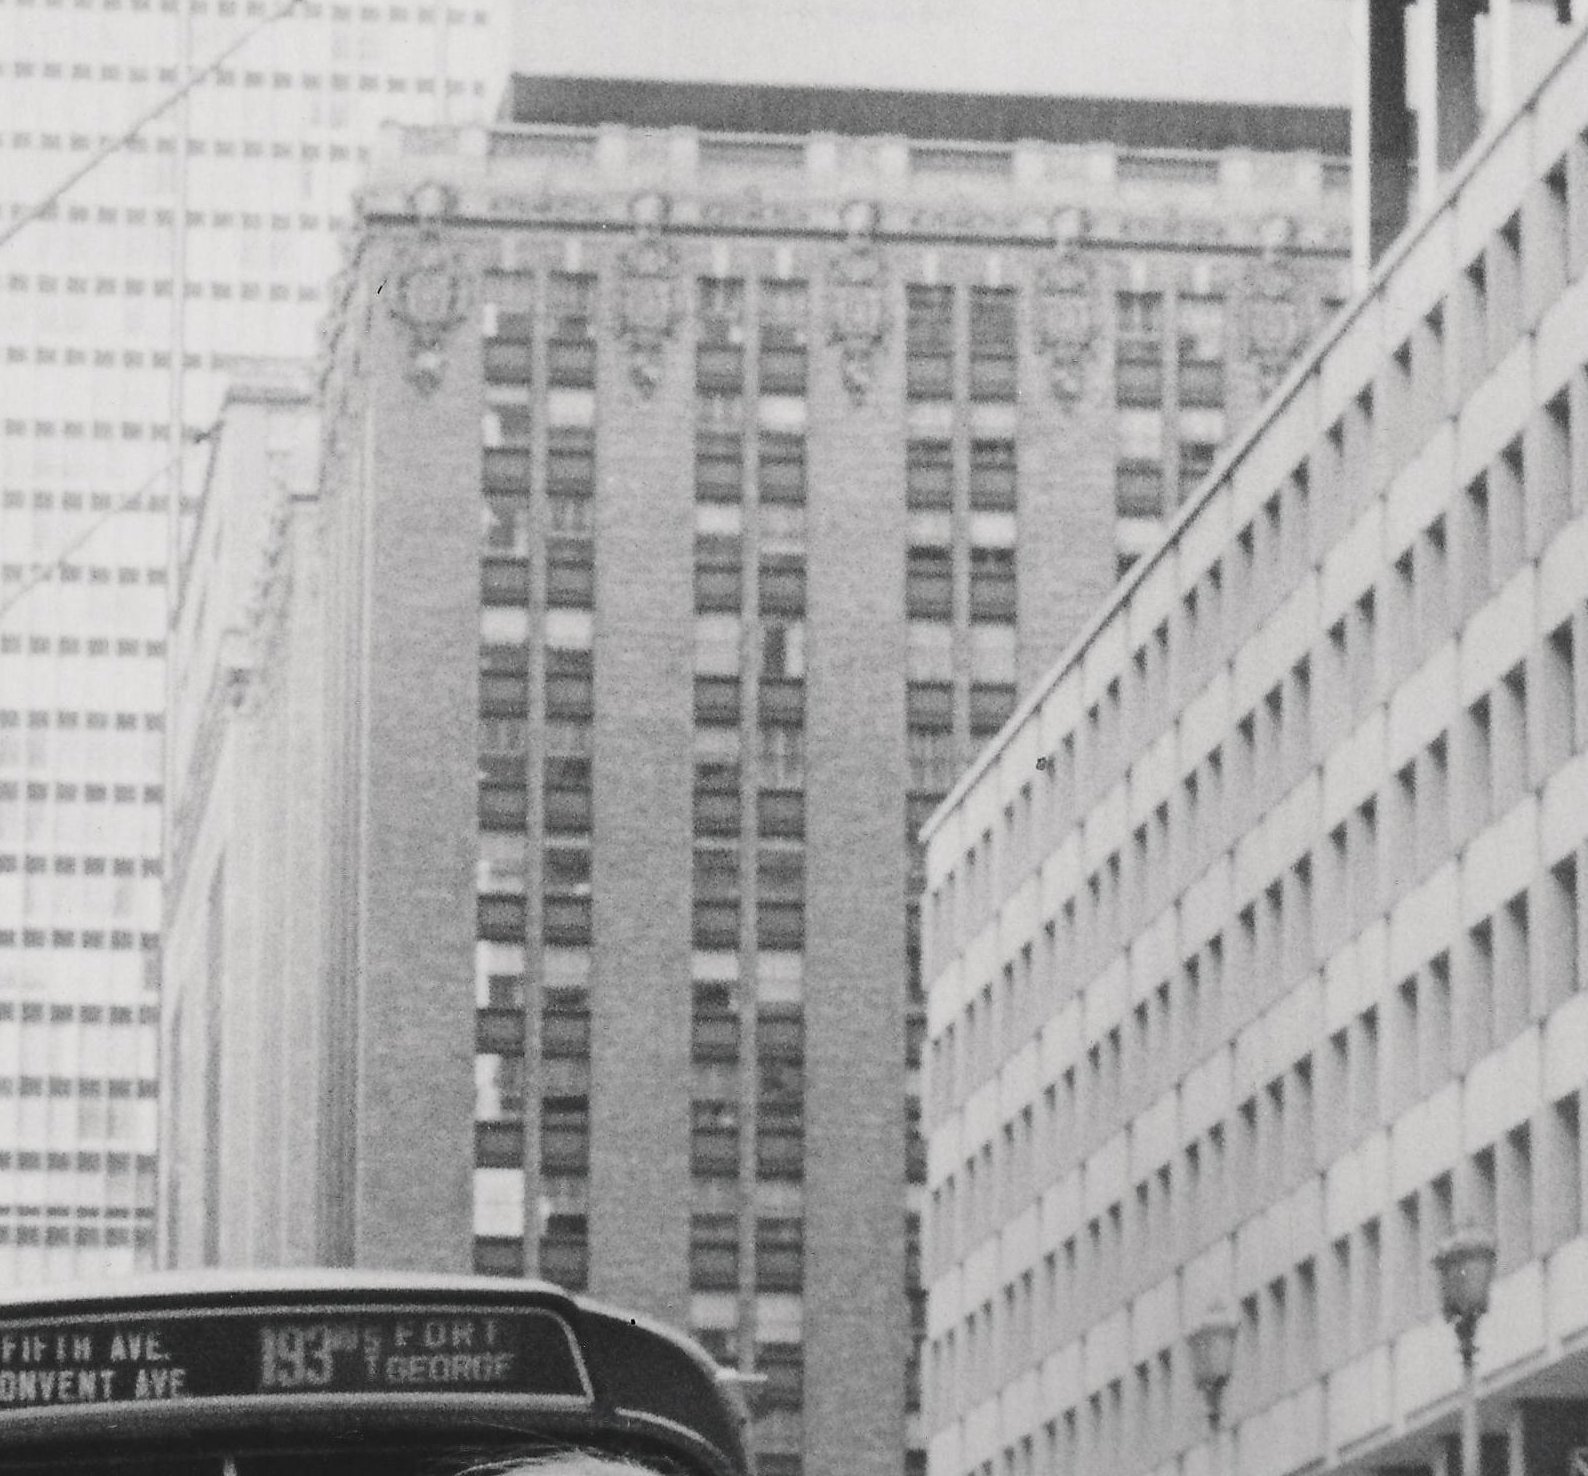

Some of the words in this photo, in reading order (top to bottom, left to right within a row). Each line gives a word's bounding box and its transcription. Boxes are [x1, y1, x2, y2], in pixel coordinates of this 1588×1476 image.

[393, 1320, 499, 1347] FORT
[1, 1335, 92, 1362] FIFTH
[385, 1352, 515, 1382] GEORGE
